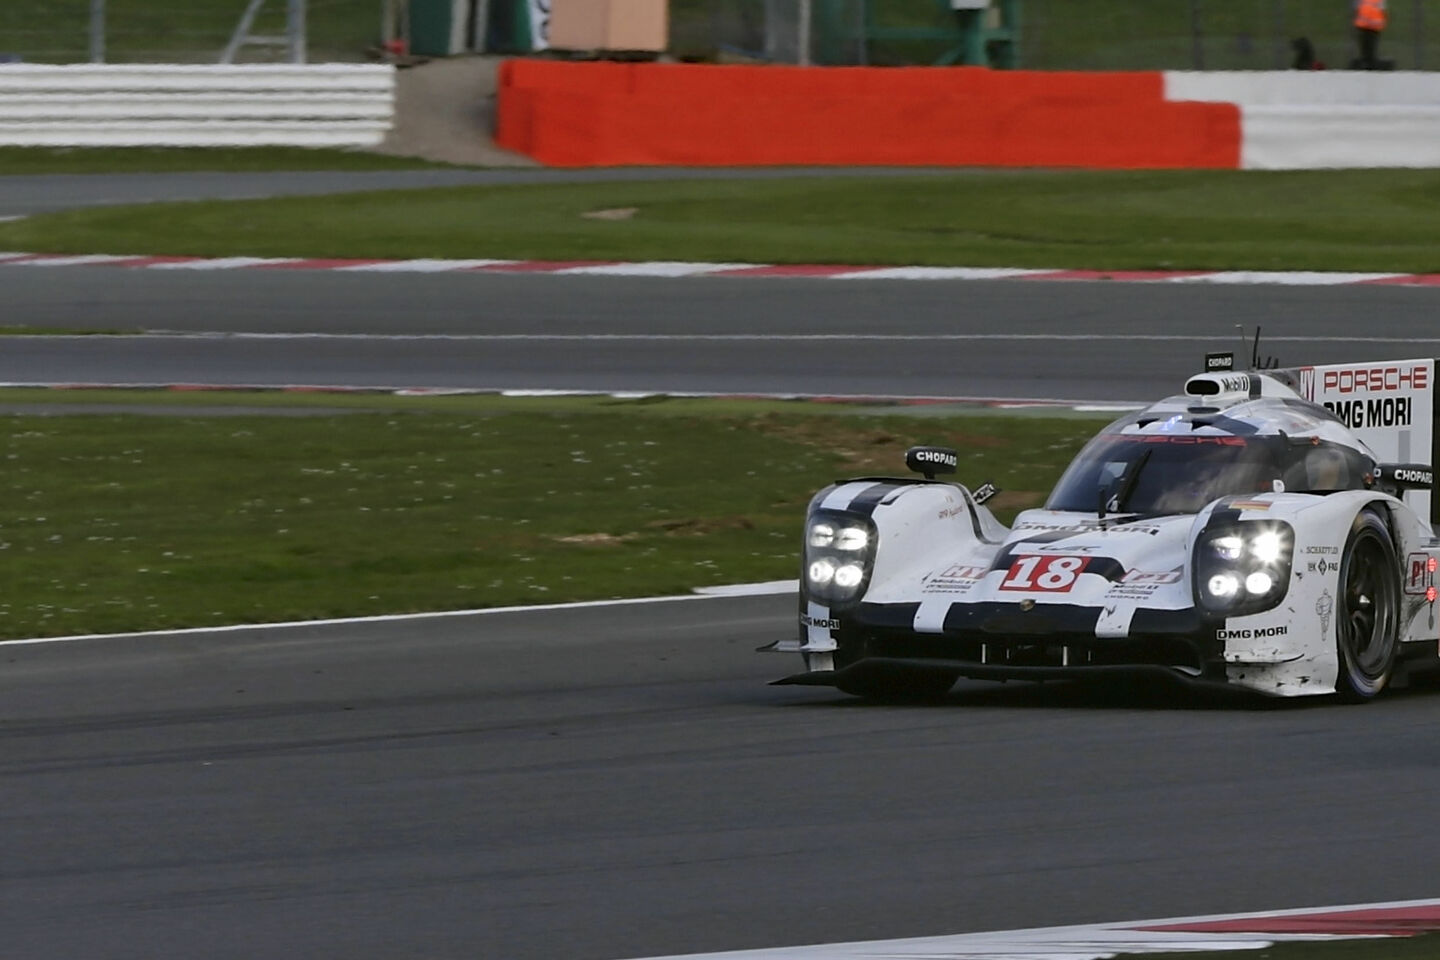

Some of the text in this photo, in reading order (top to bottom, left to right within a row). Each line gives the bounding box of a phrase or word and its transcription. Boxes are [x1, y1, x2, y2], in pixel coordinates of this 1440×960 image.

[1208, 356, 1233, 367] CHOPARD
[1323, 367, 1428, 394] PORSCHE
[1367, 397, 1412, 428] MORI
[915, 451, 957, 467] CHOPARD
[1394, 469, 1433, 484] CHOPARD
[1002, 557, 1084, 589] 18
[1411, 561, 1426, 587] P1
[813, 618, 840, 629] MORI
[1217, 625, 1288, 639] DMG MORI
